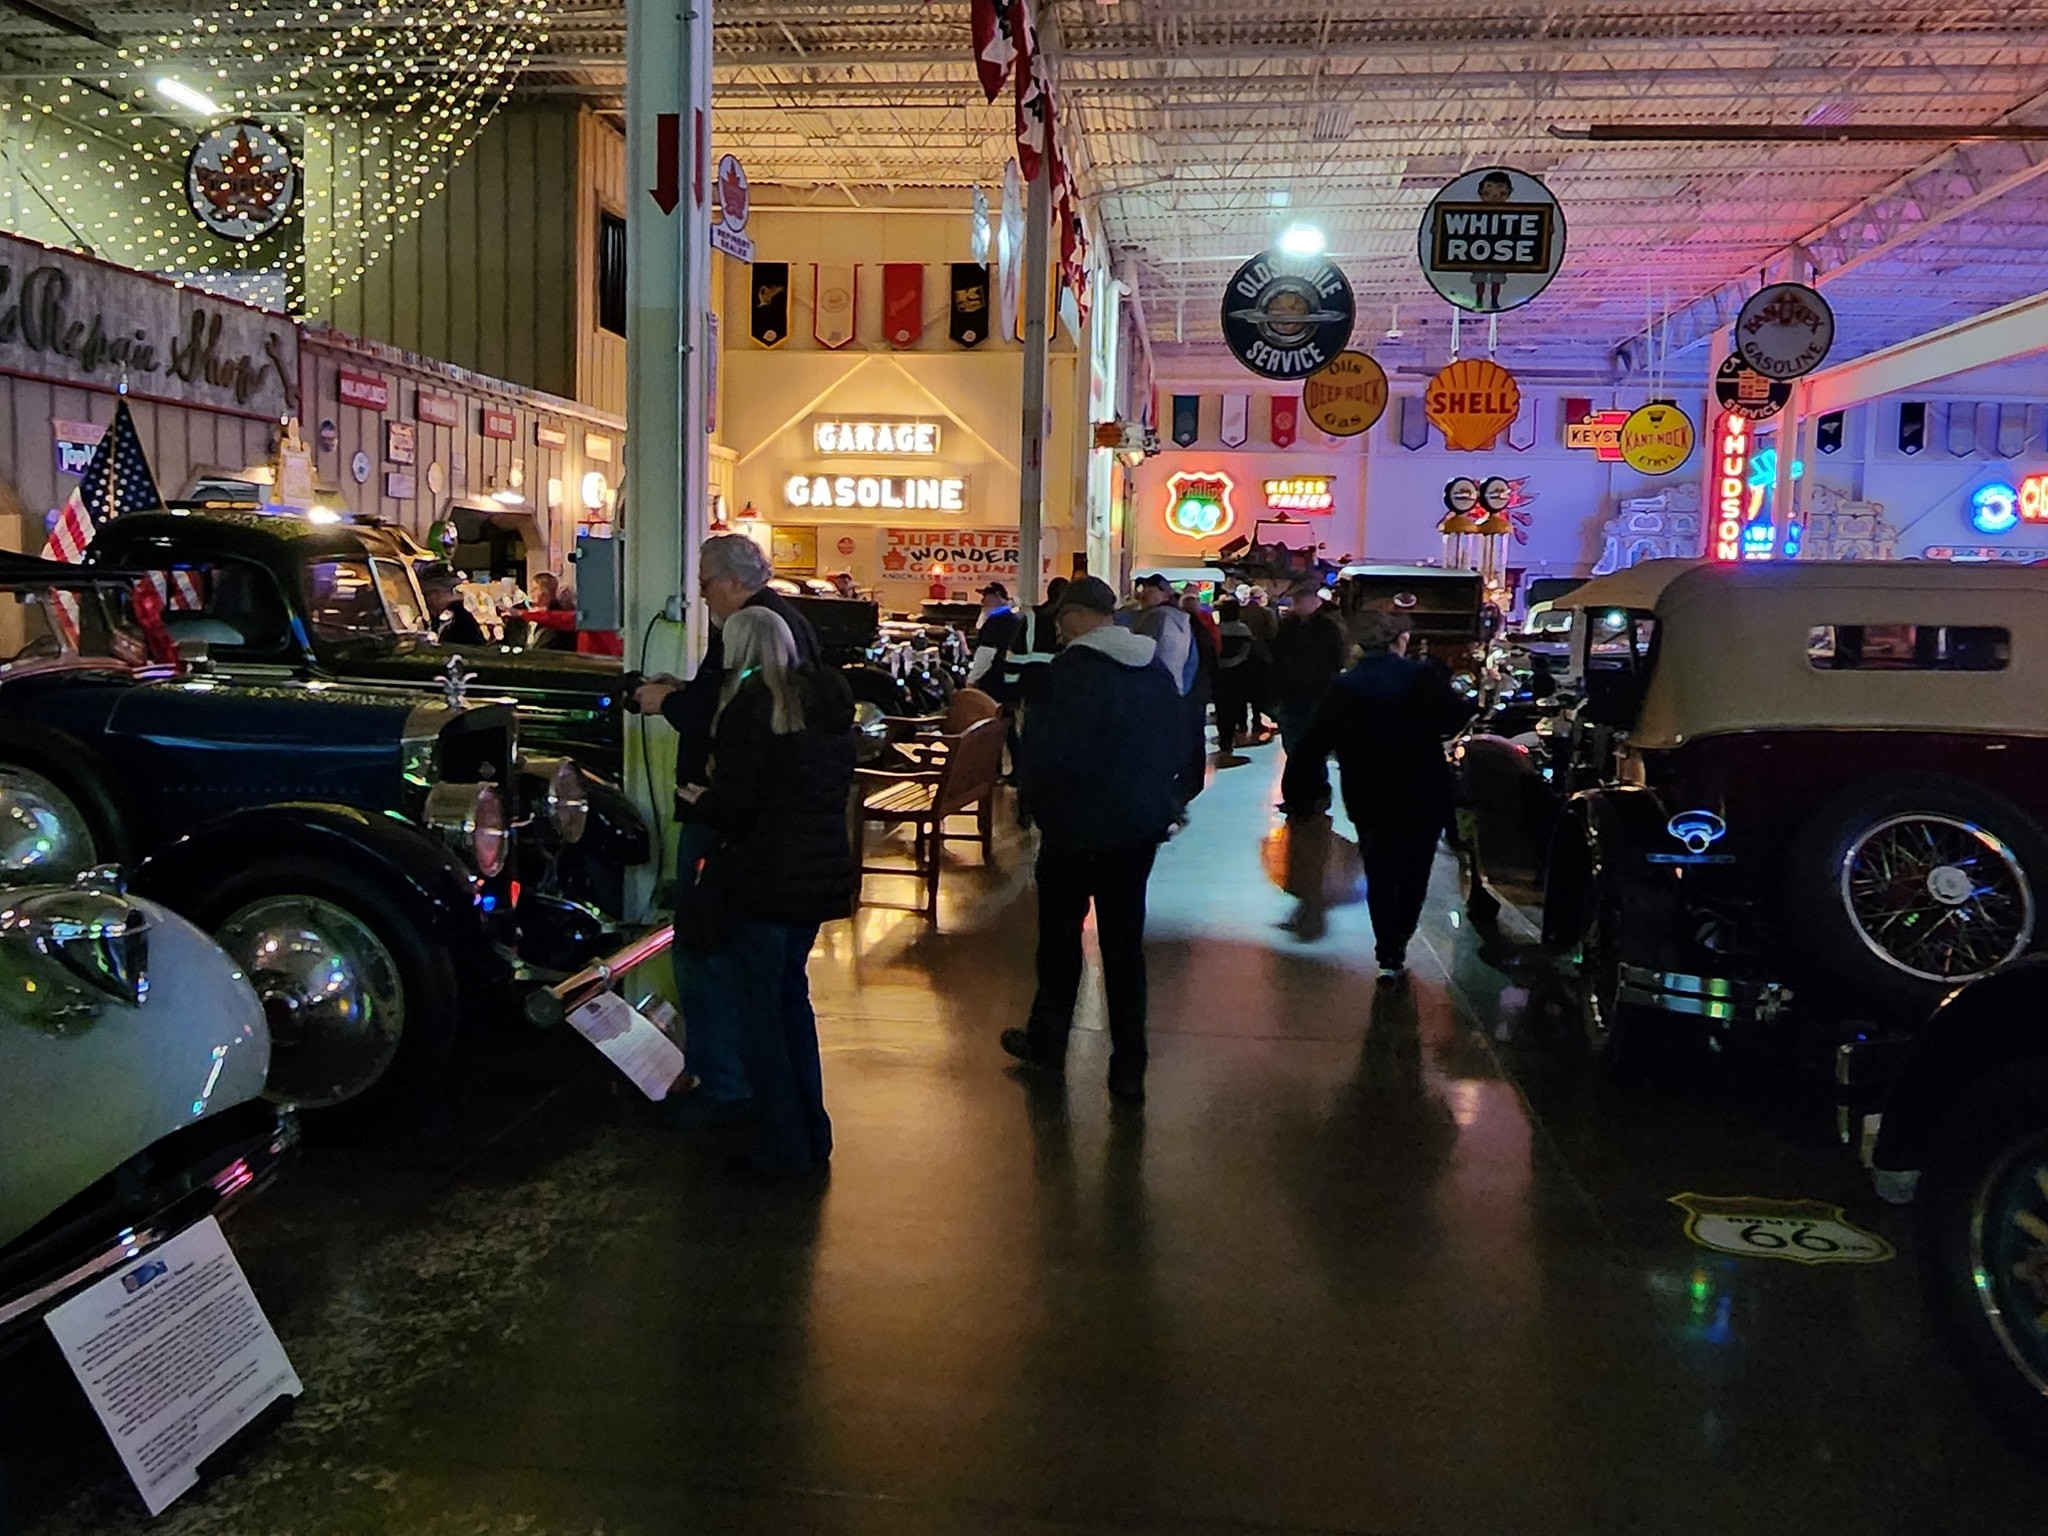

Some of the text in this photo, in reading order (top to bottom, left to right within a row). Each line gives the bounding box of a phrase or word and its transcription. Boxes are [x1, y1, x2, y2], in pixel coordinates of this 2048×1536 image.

[1445, 213, 1540, 236] WHITE
[1447, 239, 1535, 262] ROSE
[1236, 256, 1343, 299] OLDSOBILE
[1245, 340, 1325, 374] SERVICE
[1744, 341, 1824, 374] GASOLINE
[1432, 392, 1512, 414] SHELL
[1724, 398, 1781, 419] SERVICE
[1324, 411, 1362, 428] Gas
[818, 423, 935, 454] GARAGE
[1637, 453, 1677, 467] ETHYL
[784, 476, 964, 510] GASOLINE
[1717, 434, 1746, 560] HUDSON
[1740, 1224, 1841, 1252] 66
